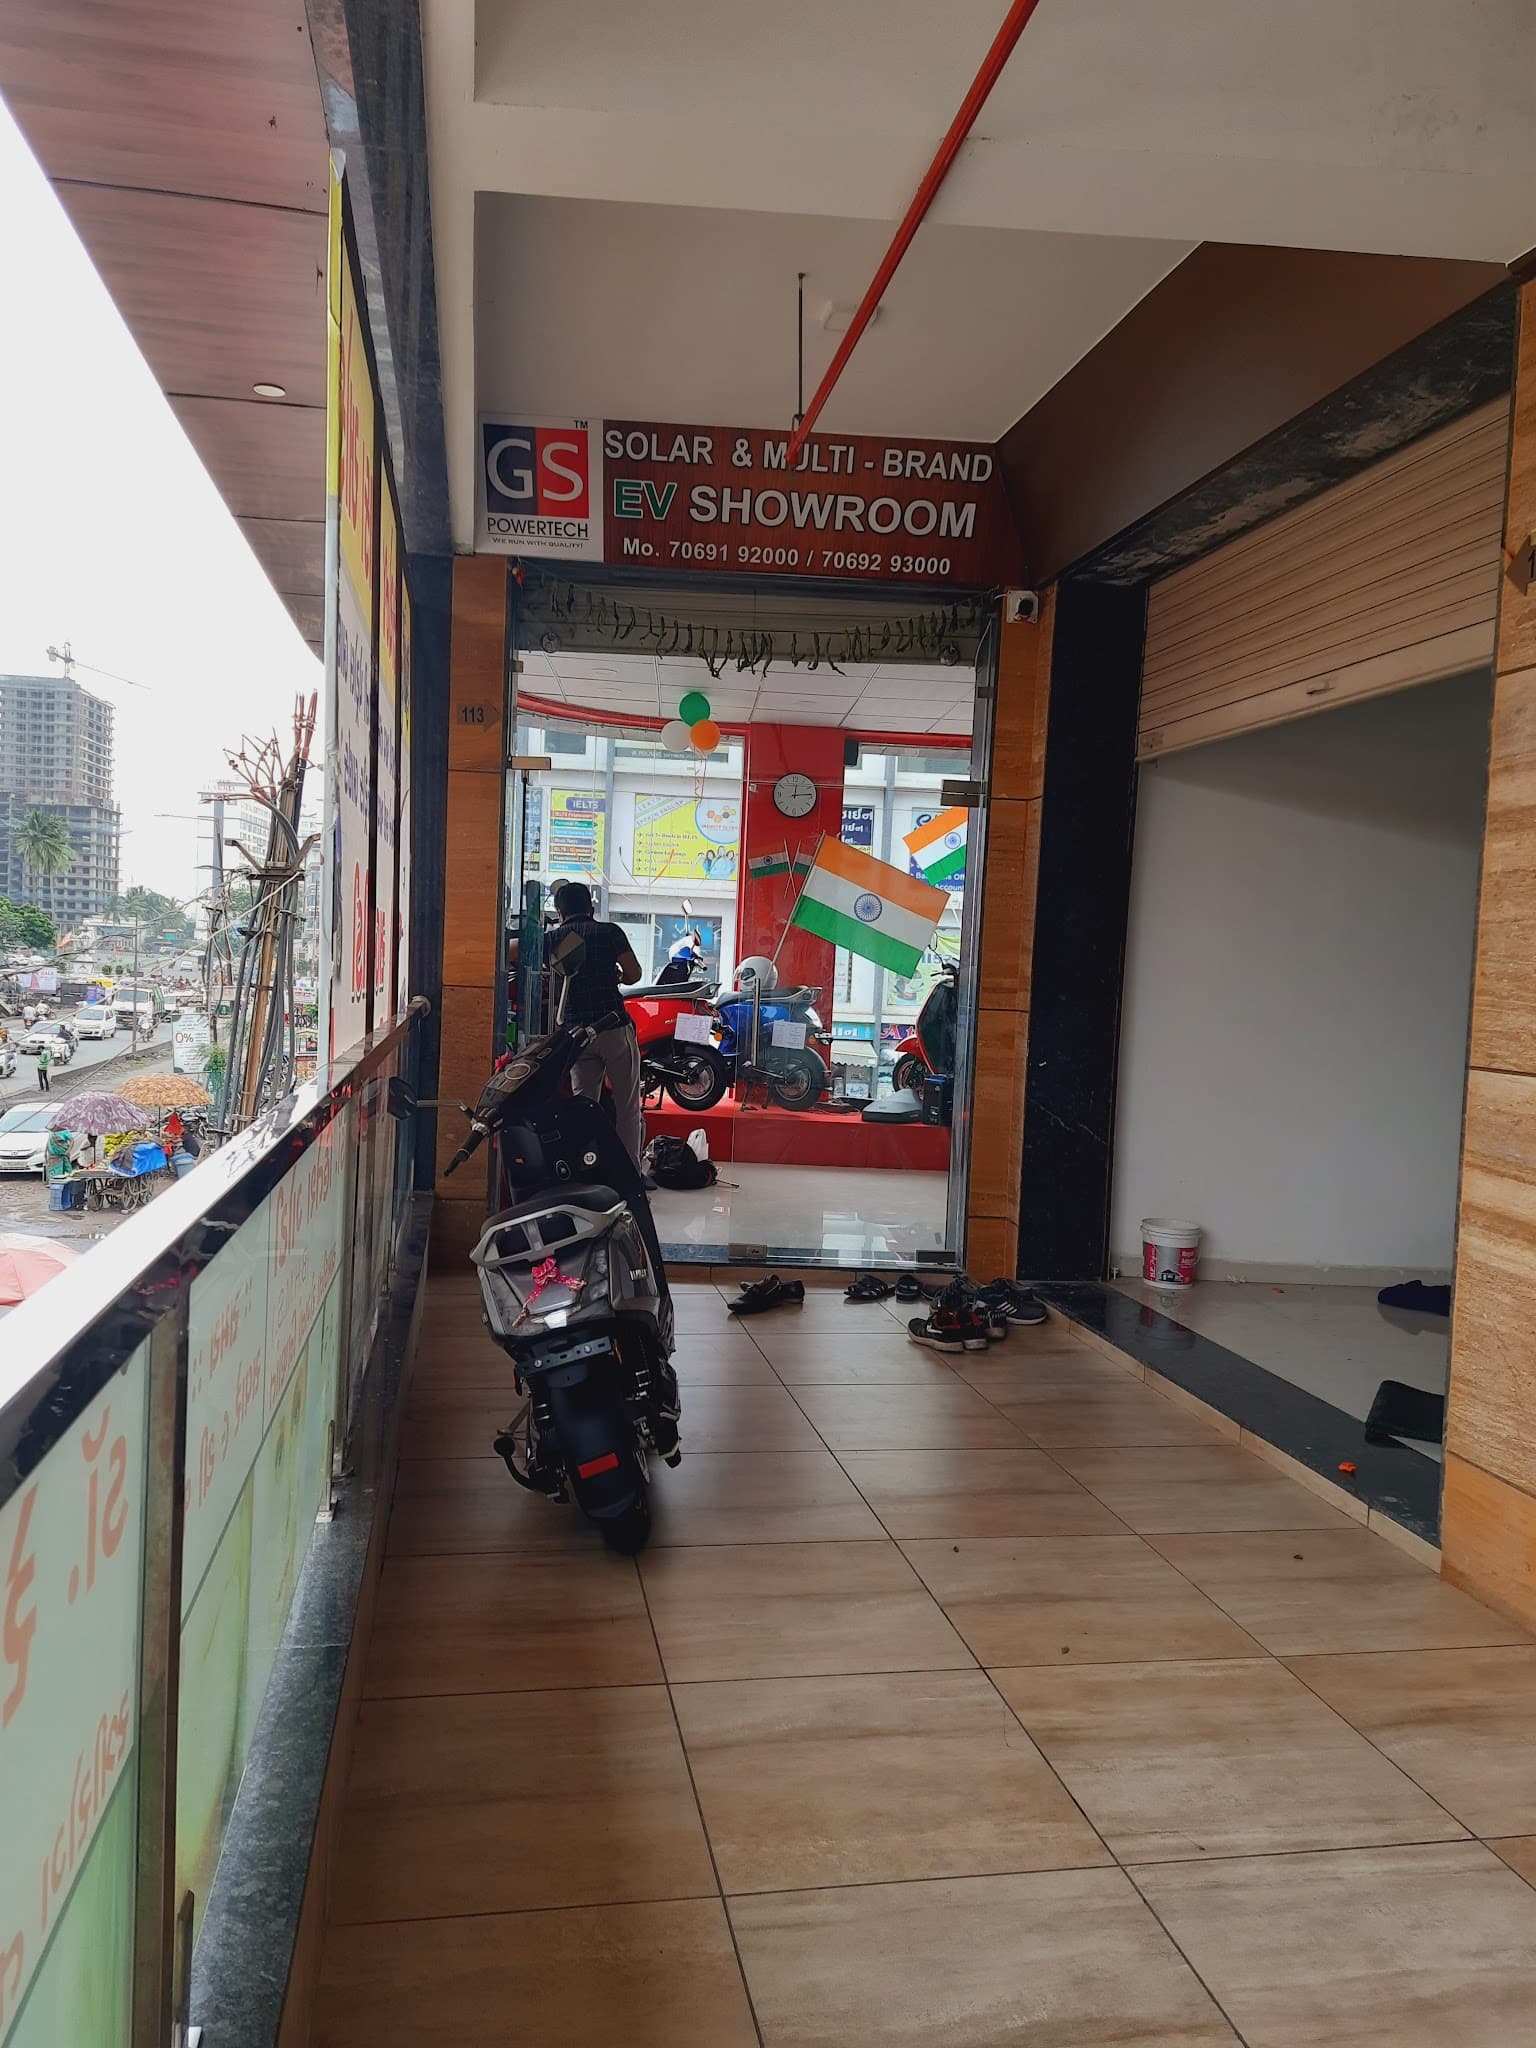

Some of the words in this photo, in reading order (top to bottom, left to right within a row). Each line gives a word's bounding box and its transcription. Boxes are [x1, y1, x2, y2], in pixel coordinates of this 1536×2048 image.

[487, 438, 584, 502] GS
[605, 430, 714, 465] SOLAR
[731, 438, 752, 467] &
[882, 448, 993, 482] BRAND
[614, 478, 678, 521] EV
[689, 485, 977, 538] SHOWROOM
[487, 517, 589, 538] POWERTECH
[623, 537, 660, 557] Mo.
[669, 540, 728, 562] 70691
[738, 545, 799, 566] 92000
[821, 550, 881, 571] 70692
[890, 555, 950, 575] 93000
[462, 706, 485, 723] 113
[572, 800, 599, 809] IELTS
[175, 1032, 194, 1043] 0%
